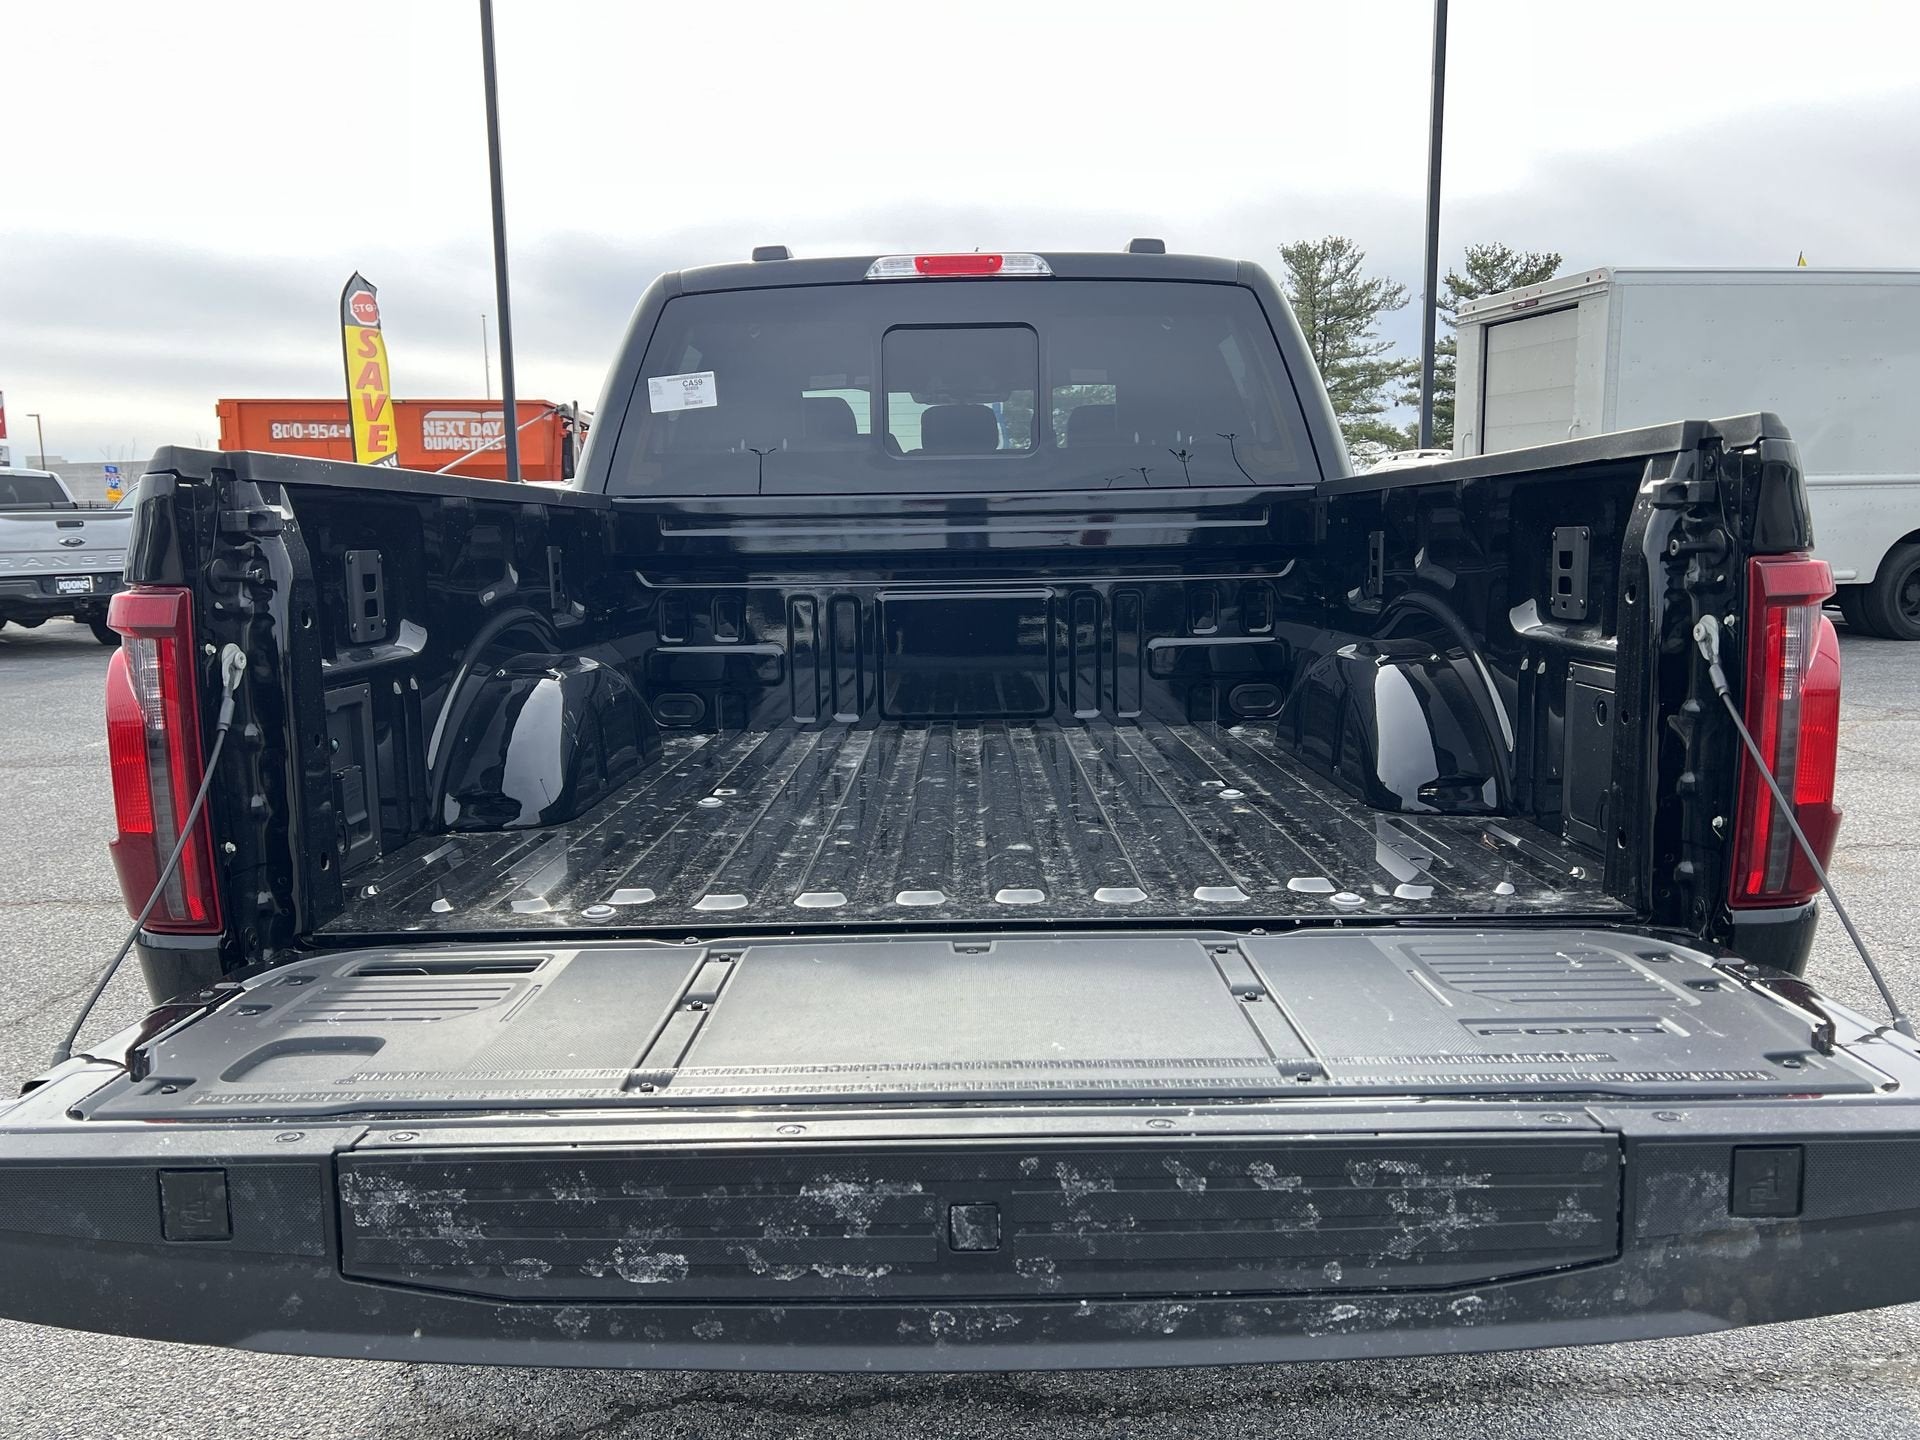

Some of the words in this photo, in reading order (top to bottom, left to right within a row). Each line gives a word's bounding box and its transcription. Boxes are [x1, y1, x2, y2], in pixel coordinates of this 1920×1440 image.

[682, 378, 703, 388] CA59
[356, 329, 389, 453] SAVE
[423, 420, 465, 436] NEXT
[469, 421, 502, 437] DAY
[423, 436, 502, 451] DUMPSTERS
[0, 553, 123, 568] RANGE
[58, 580, 90, 590] KOONS
[1477, 1026, 1669, 1036] FORD
